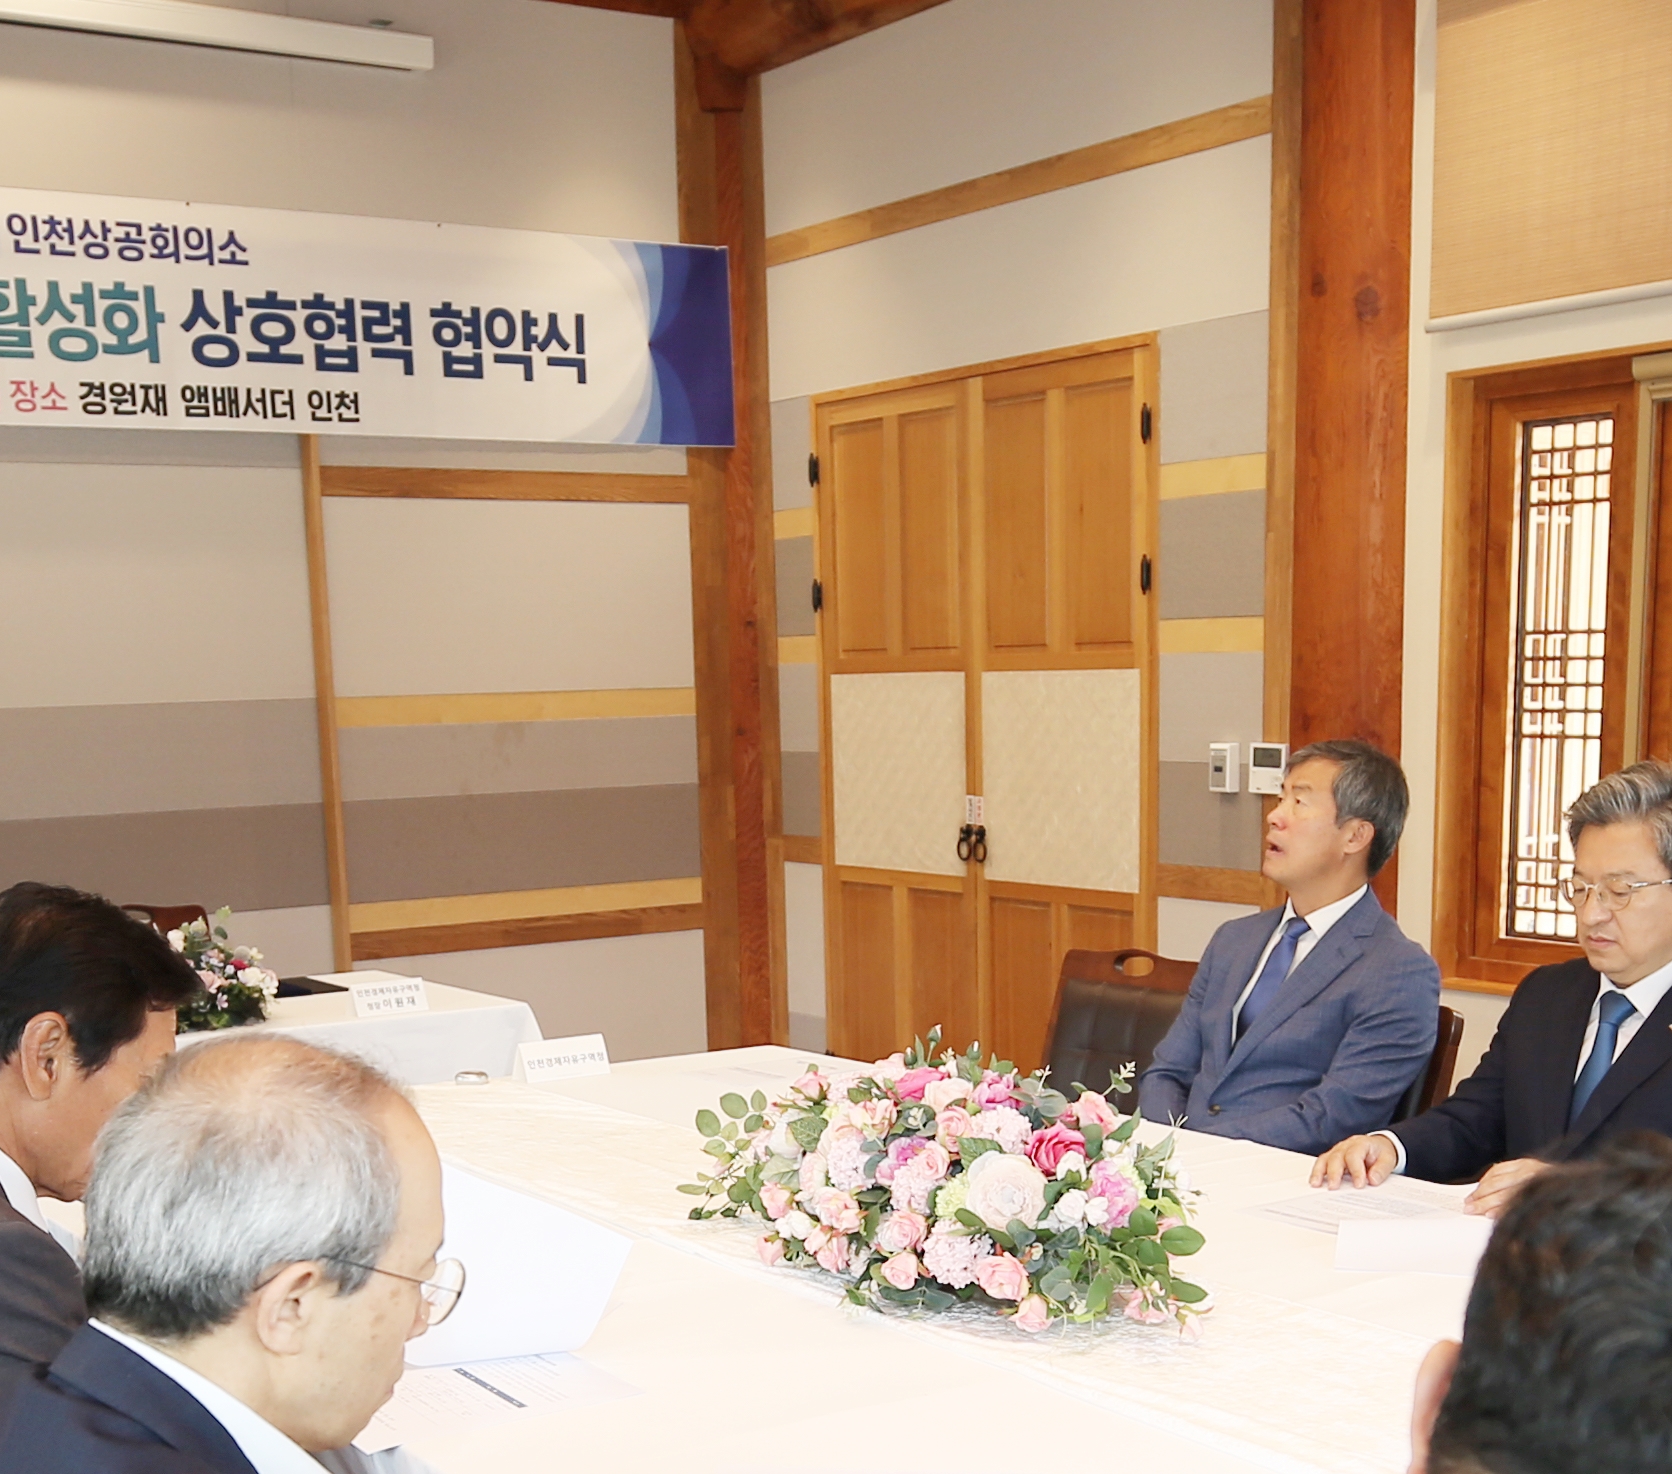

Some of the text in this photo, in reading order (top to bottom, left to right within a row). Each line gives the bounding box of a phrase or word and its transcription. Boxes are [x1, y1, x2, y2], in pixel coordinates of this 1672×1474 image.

[5, 212, 250, 267] 인천상공회의소
[178, 287, 415, 377] 상호협력
[428, 300, 588, 385] 협약식
[9, 379, 361, 424] 장소 경원재 앰배서더 인천
